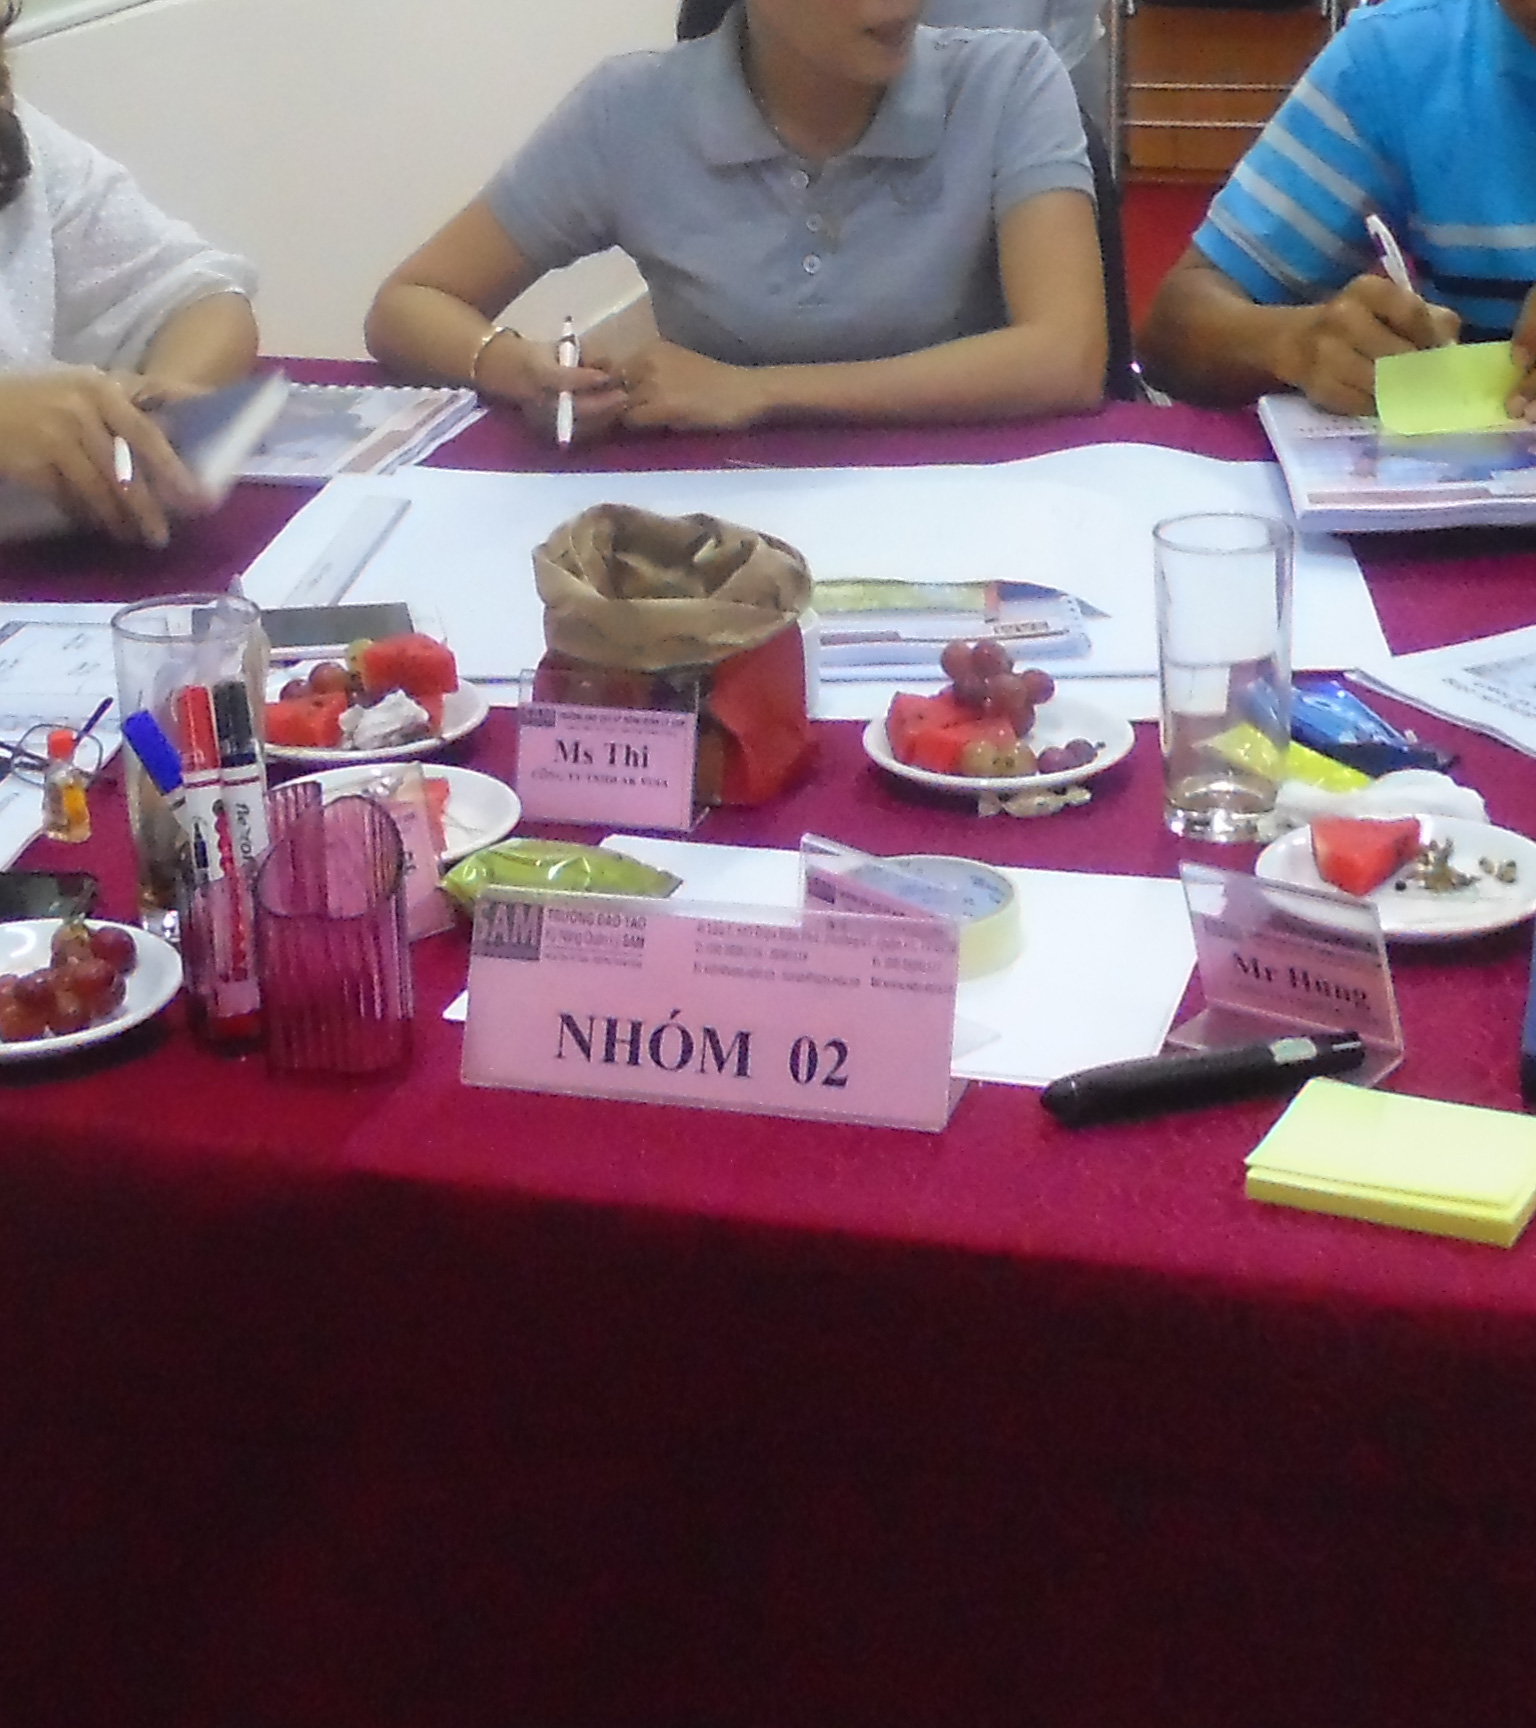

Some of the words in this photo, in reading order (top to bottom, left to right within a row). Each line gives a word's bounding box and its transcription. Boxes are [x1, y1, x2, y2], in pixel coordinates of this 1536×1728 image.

[554, 738, 594, 764] Ms
[604, 741, 649, 768] Thi
[556, 1009, 752, 1079] NHÓM
[788, 1035, 850, 1089] 02
